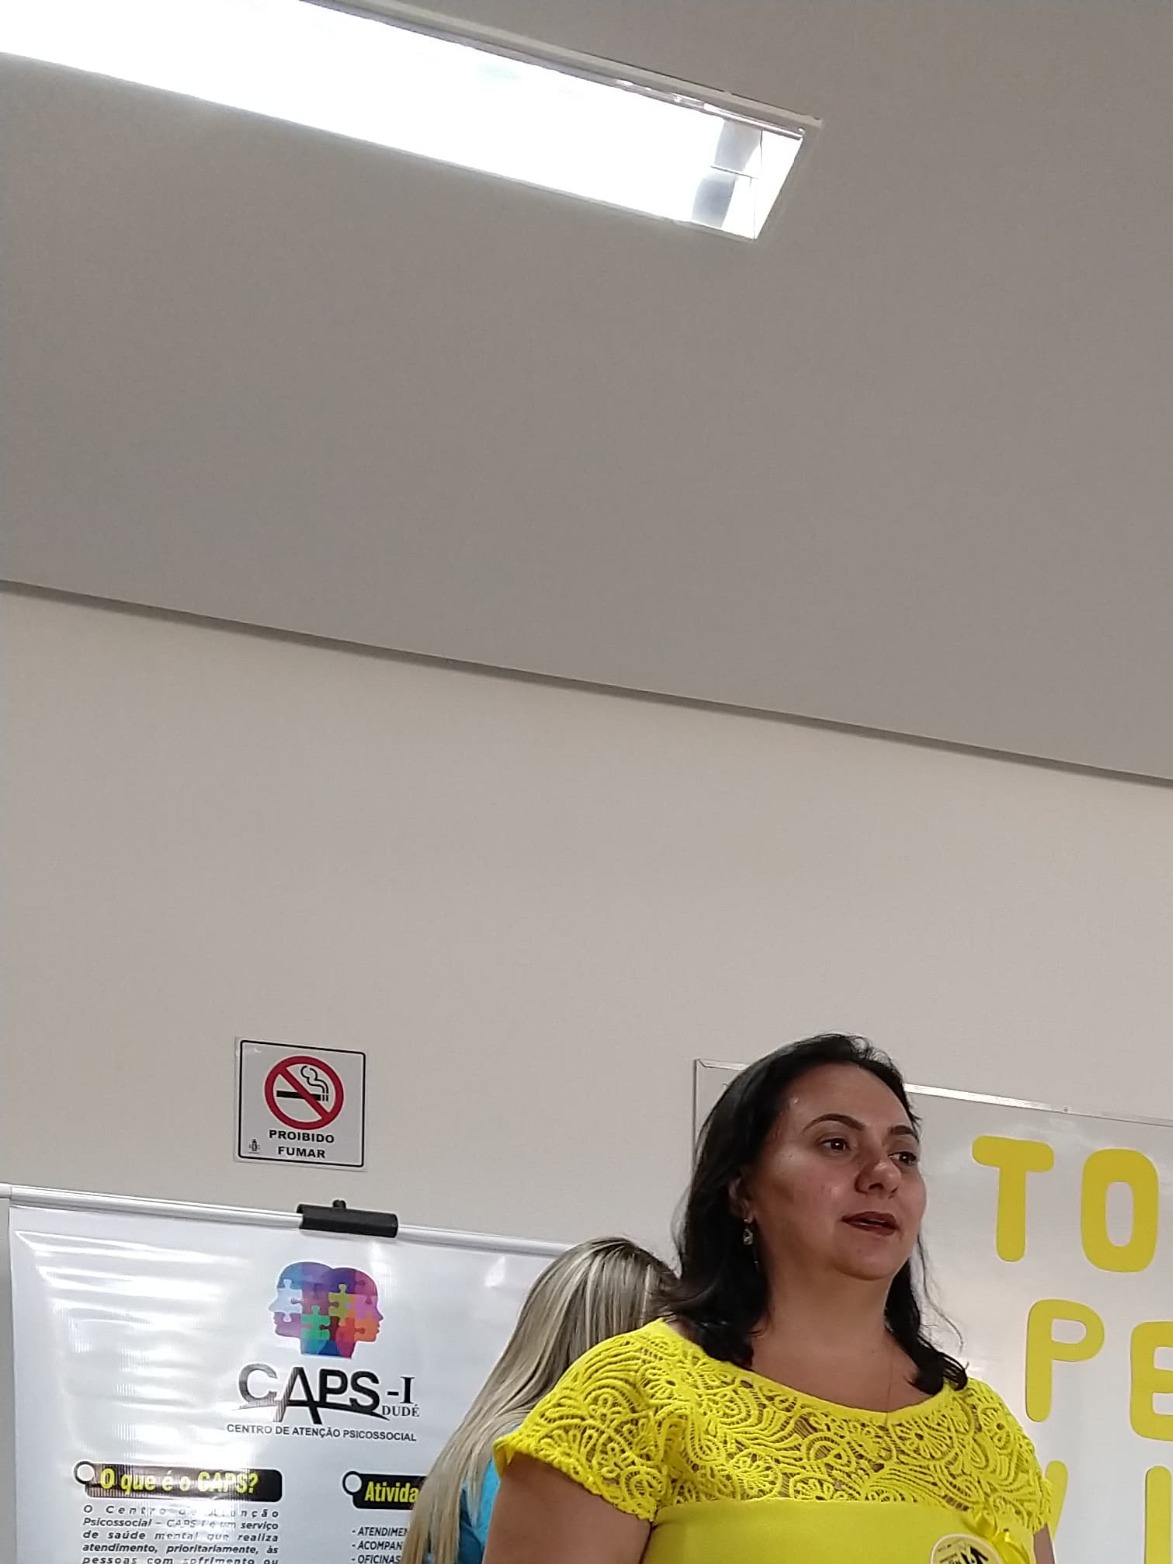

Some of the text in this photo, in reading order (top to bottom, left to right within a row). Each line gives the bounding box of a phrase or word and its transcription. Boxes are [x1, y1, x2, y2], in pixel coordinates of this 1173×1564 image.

[269, 1130, 335, 1143] PROIBIDO
[278, 1146, 325, 1158] FUMAR
[382, 1404, 420, 1417] DUDÉ
[227, 1424, 417, 1441] CENTRO DE ATENÇÃO PSICOSSOCIAL
[100, 1468, 259, 1494] O que é o CAPS?
[83, 1505, 93, 1514] O
[83, 1517, 279, 1532] Psicossocial serviço
[83, 1531, 98, 1539] de
[108, 1530, 146, 1540] saúde
[238, 1534, 278, 1542] realiza
[83, 1544, 158, 1554] atendimento,
[166, 1545, 259, 1555] prioritariamente,
[147, 1557, 174, 1564] com
[358, 1555, 401, 1564] OFICINAS
